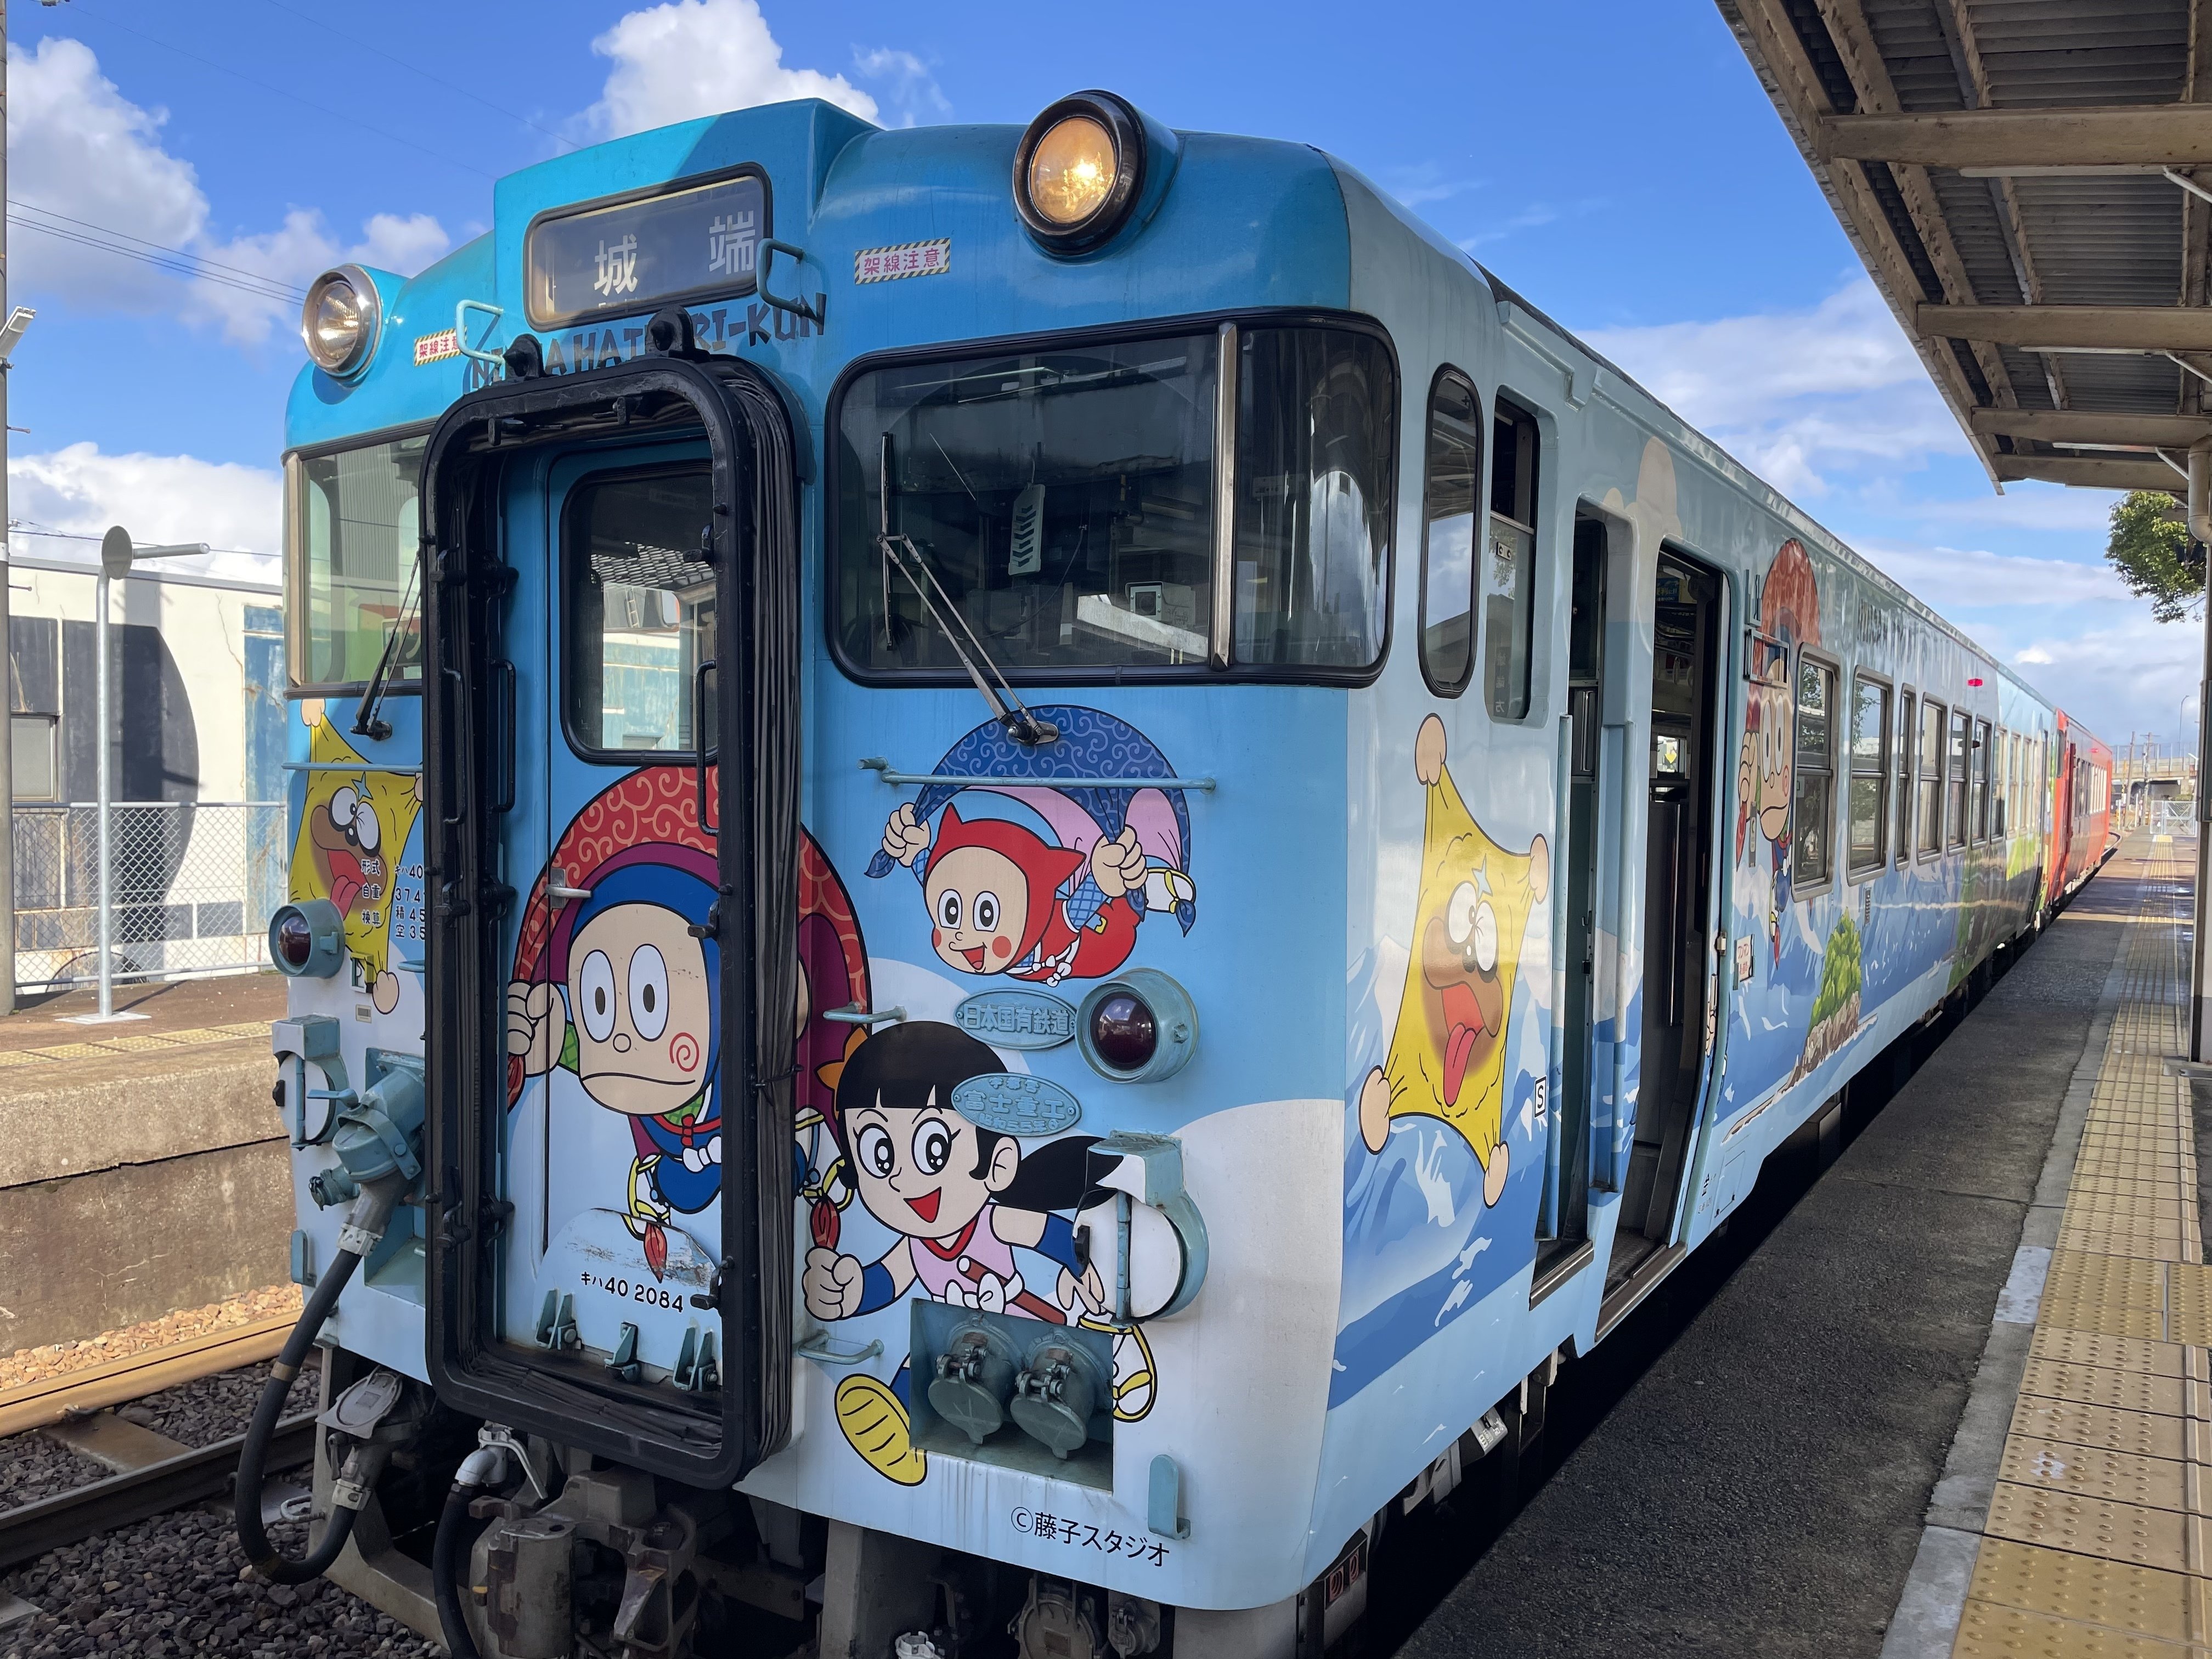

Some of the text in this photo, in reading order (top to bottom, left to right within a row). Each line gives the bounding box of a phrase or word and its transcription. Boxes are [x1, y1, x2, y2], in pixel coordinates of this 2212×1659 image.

[864, 248, 940, 275] 架線注意
[573, 292, 827, 370] HATRI-KUN
[362, 859, 423, 879] 形式 キハ40
[363, 885, 425, 902] 自重 37.4
[362, 911, 380, 924] 換算
[396, 924, 405, 938] 空
[963, 1003, 1069, 1035] 日本国有鉄道
[964, 1090, 1065, 1120] 富士重工
[581, 1272, 683, 1312] キハ40 2084
